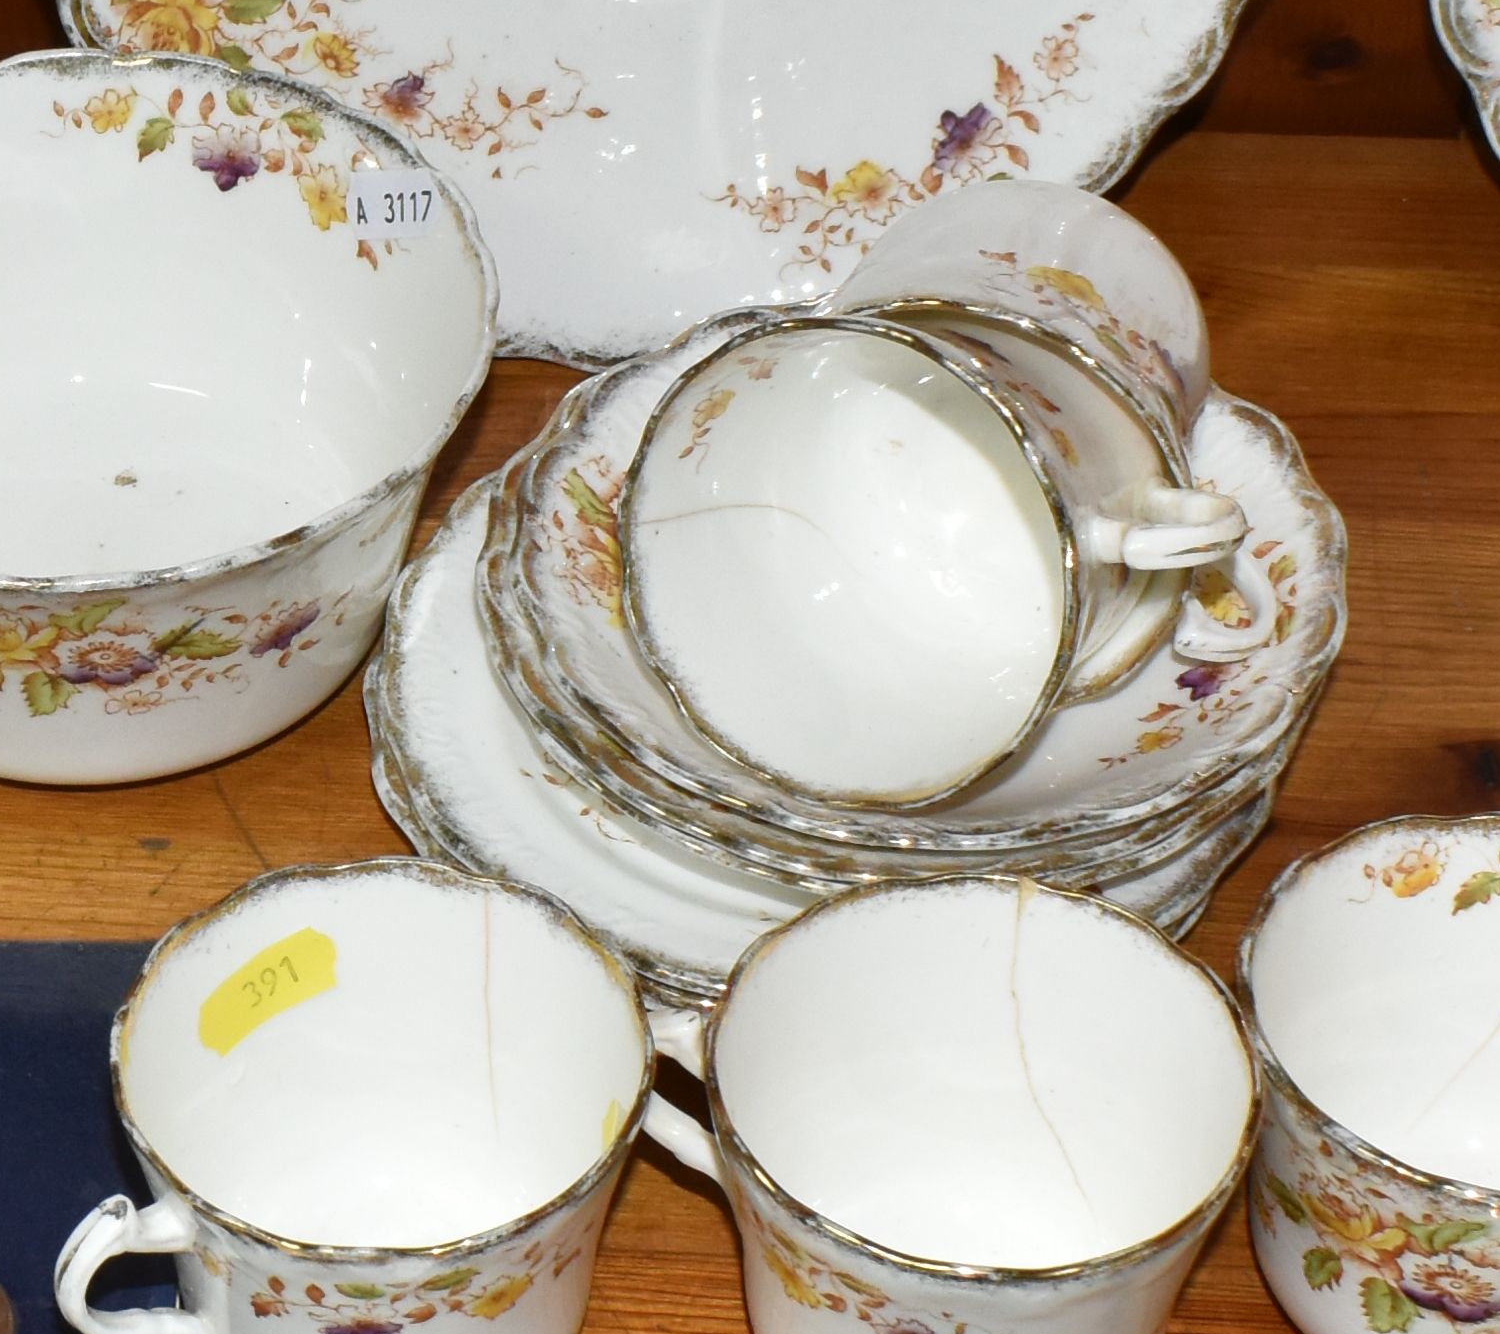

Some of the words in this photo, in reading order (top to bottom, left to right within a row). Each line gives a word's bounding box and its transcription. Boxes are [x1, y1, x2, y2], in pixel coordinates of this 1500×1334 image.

[357, 196, 368, 223] A
[385, 191, 432, 223] 3117
[242, 956, 298, 1008] 391
